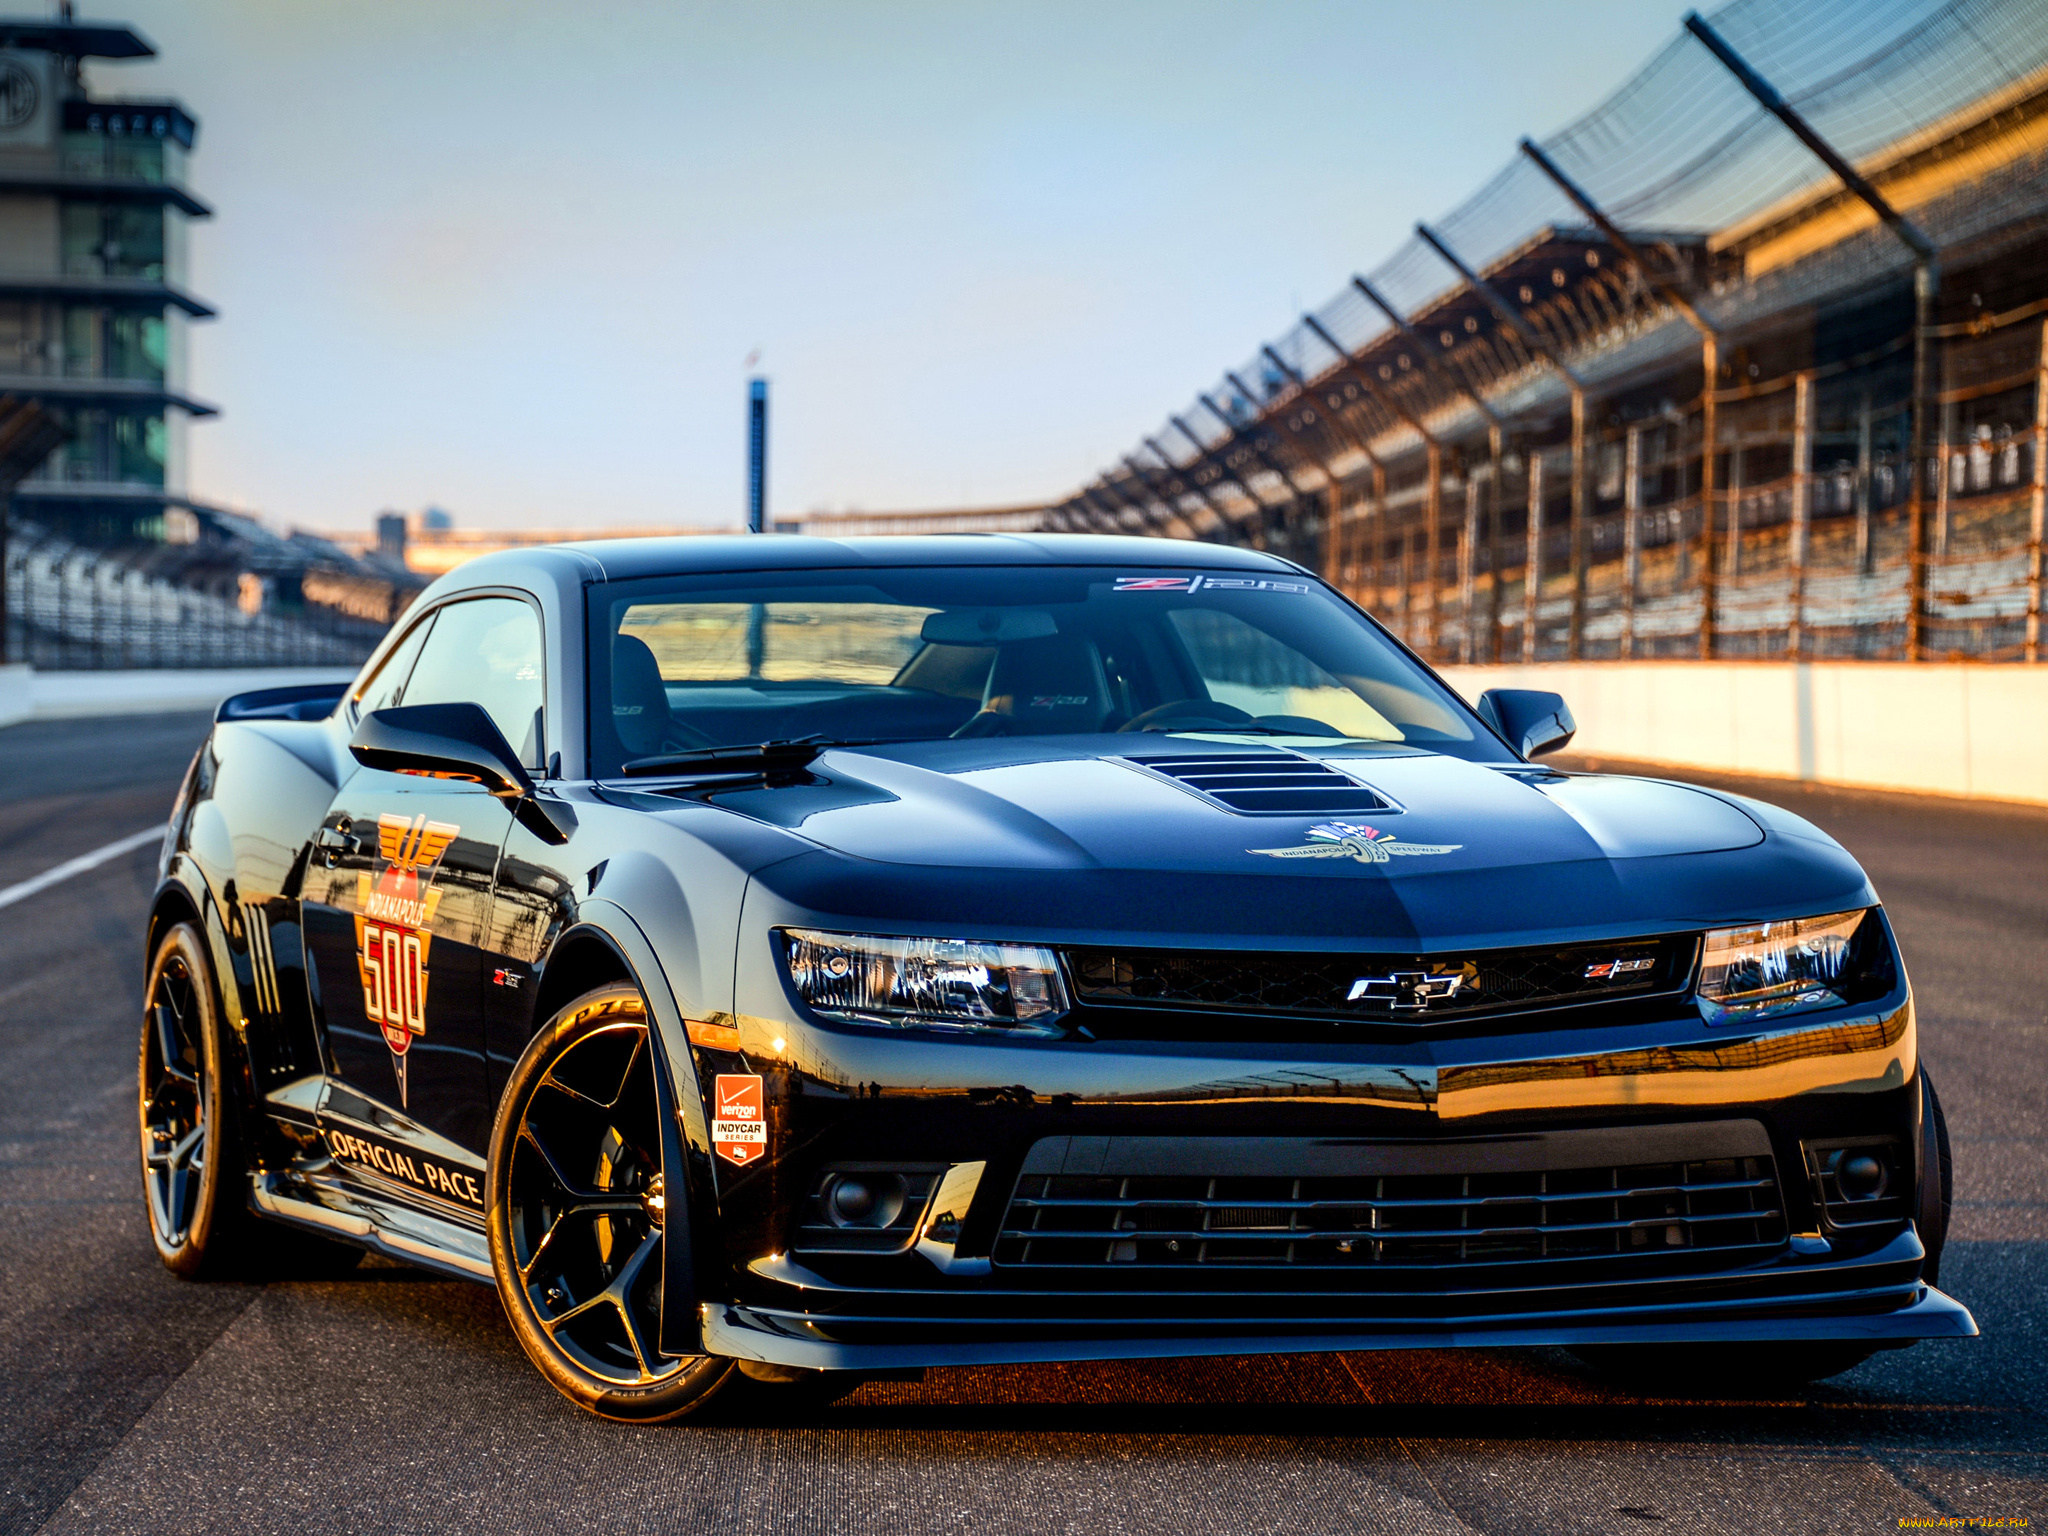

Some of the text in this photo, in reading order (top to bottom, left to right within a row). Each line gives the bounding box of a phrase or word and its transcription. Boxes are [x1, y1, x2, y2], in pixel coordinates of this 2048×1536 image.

[1282, 845, 1350, 857] INDIANAPOLIS
[1390, 846, 1442, 854] SPEEDWAY
[365, 892, 427, 927] INDIANAPOLIS
[363, 924, 425, 1034] 500
[574, 1008, 590, 1027] P
[721, 1102, 756, 1119] verizon
[717, 1124, 761, 1133] INDYCAR
[331, 1130, 483, 1205] OFFICIAL PACE
